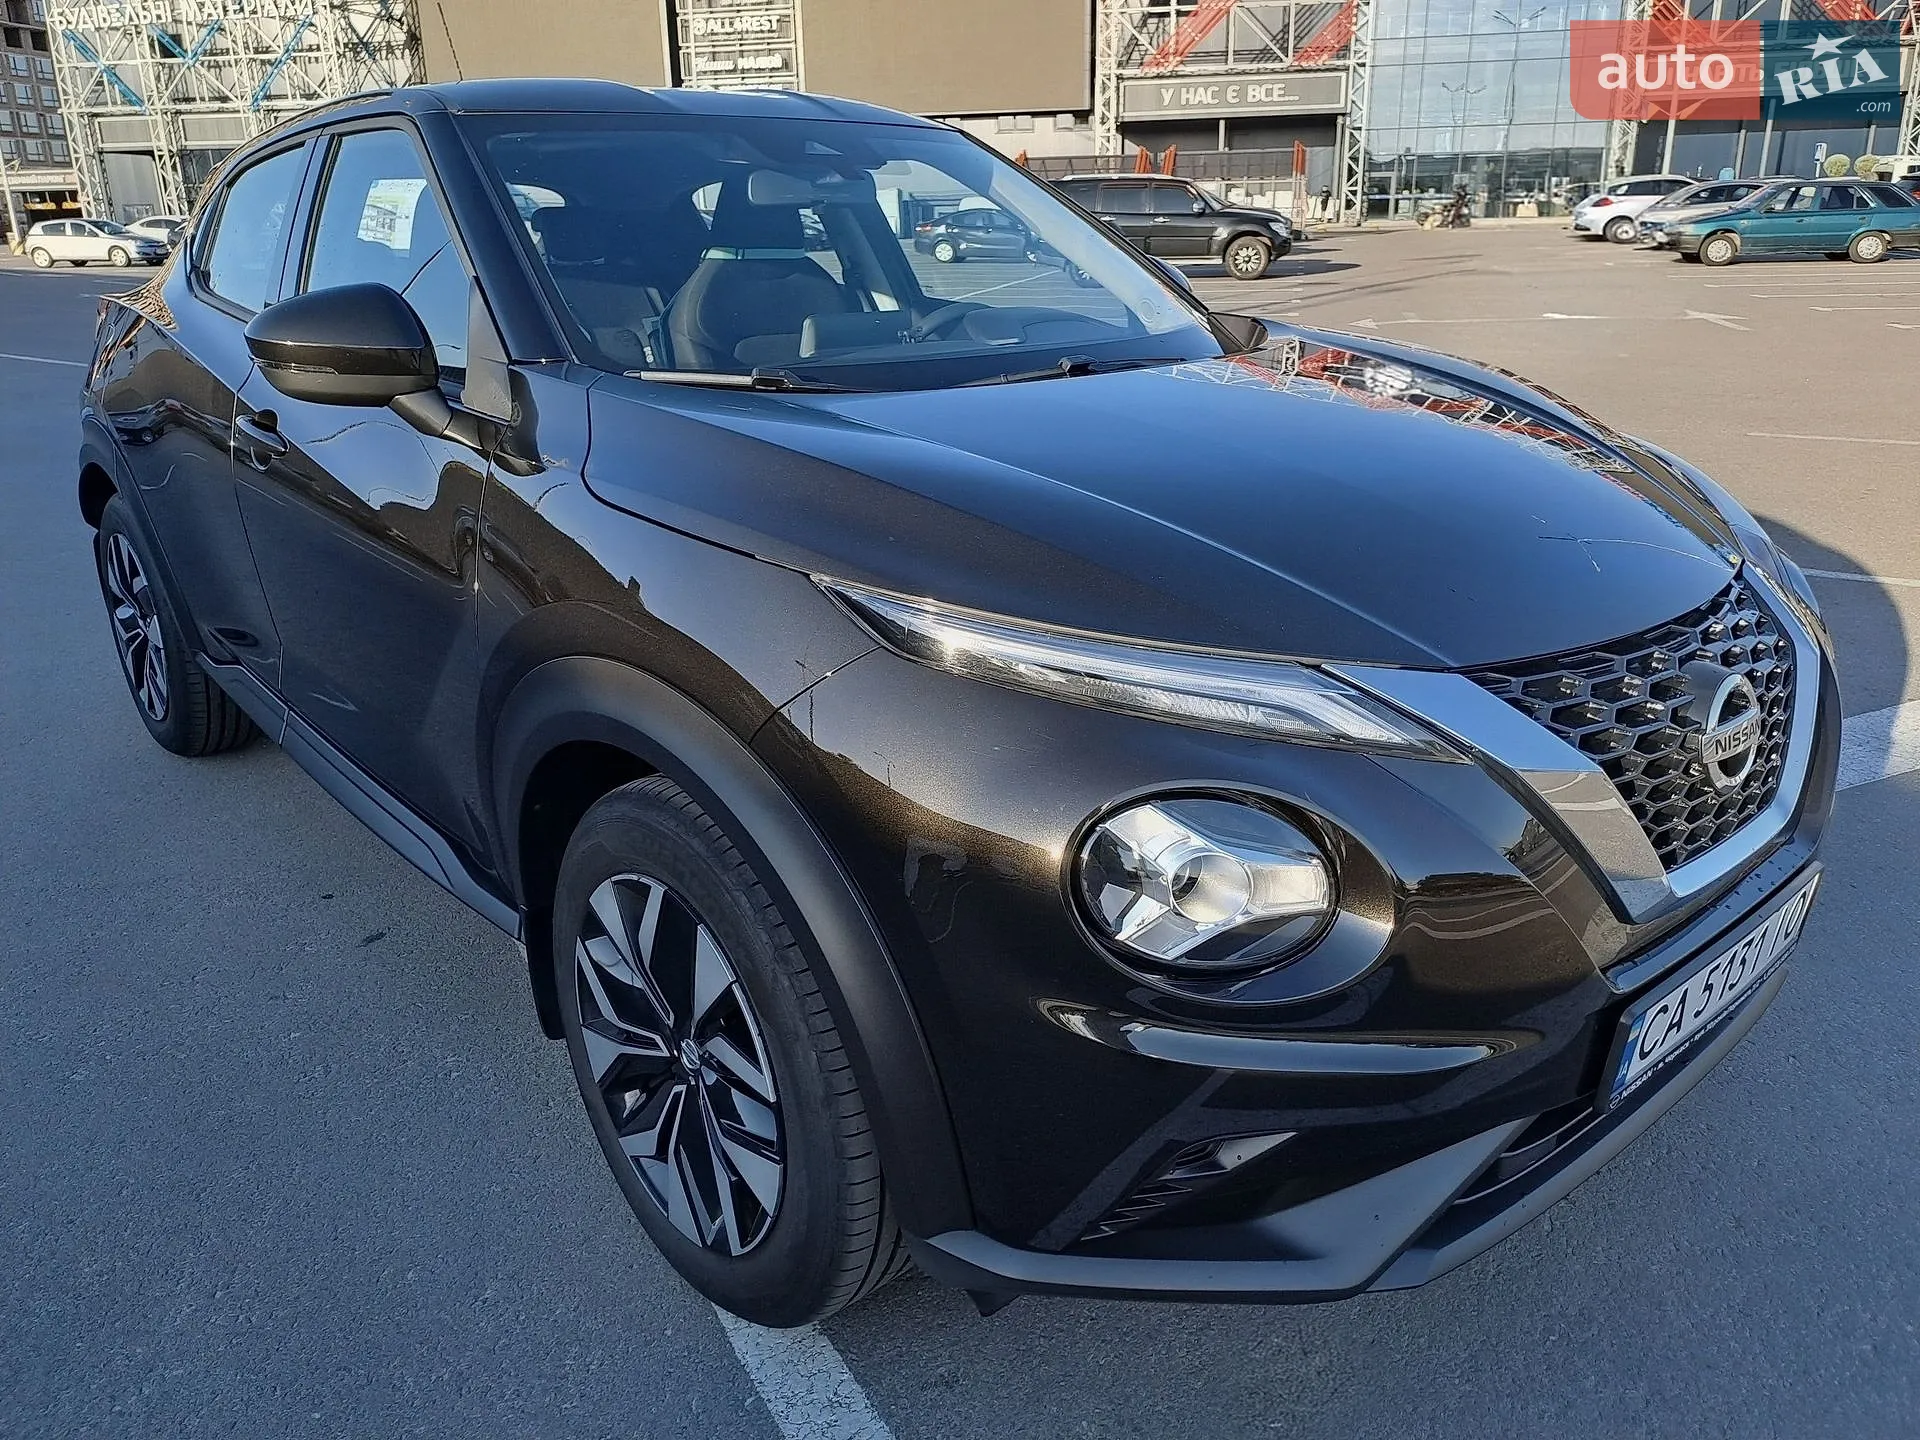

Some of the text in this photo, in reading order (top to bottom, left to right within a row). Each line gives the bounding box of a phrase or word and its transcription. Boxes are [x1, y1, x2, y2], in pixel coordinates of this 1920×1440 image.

[1160, 88, 1175, 106] У
[1180, 86, 1220, 105] НАС
[1226, 85, 1240, 103] Є
[1714, 718, 1760, 755] NISSAN
[1639, 987, 1689, 1061] CA
